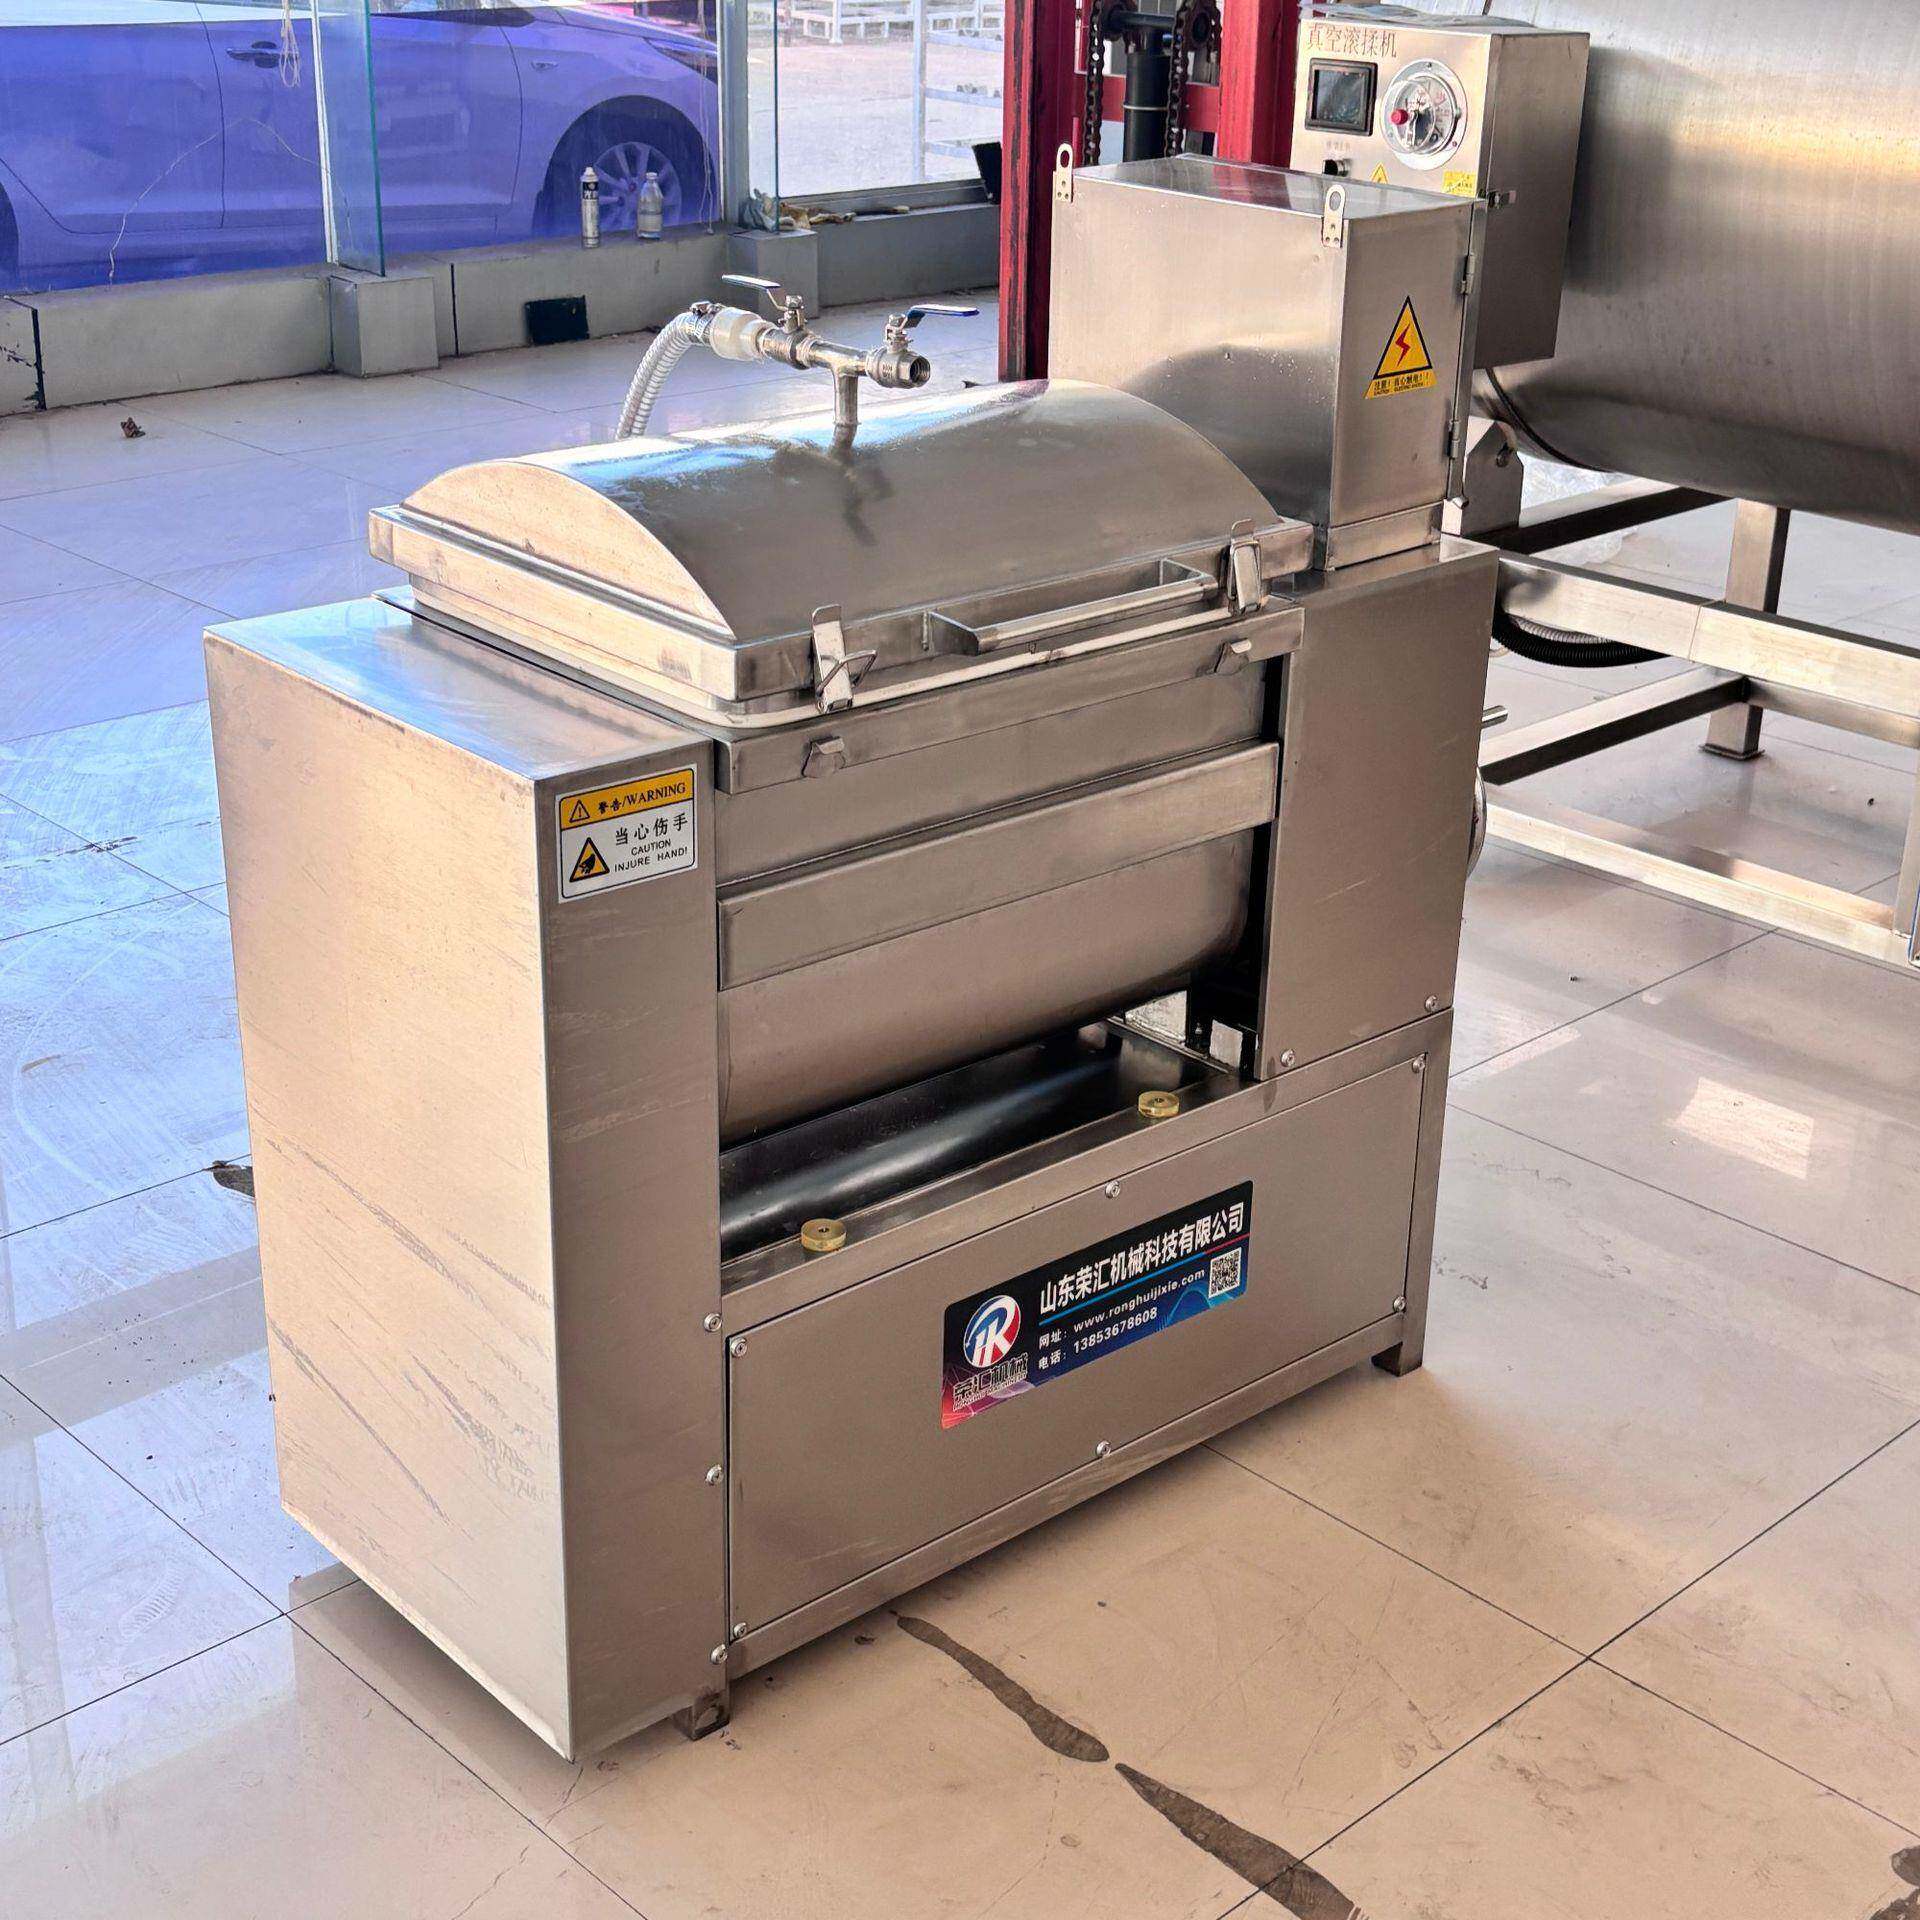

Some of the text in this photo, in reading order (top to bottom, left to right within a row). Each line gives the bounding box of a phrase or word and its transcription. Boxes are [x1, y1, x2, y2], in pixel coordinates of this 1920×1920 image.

[615, 812, 688, 846] 当心伤手
[631, 838, 672, 856] CAUTION
[614, 846, 688, 873] INJURE HAND!
[1040, 1202, 1244, 1315] 山东荣汇机械科技有限公司
[1073, 1268, 1205, 1333] www.ronghuijixie.com
[1073, 1306, 1158, 1354] 13853678608
